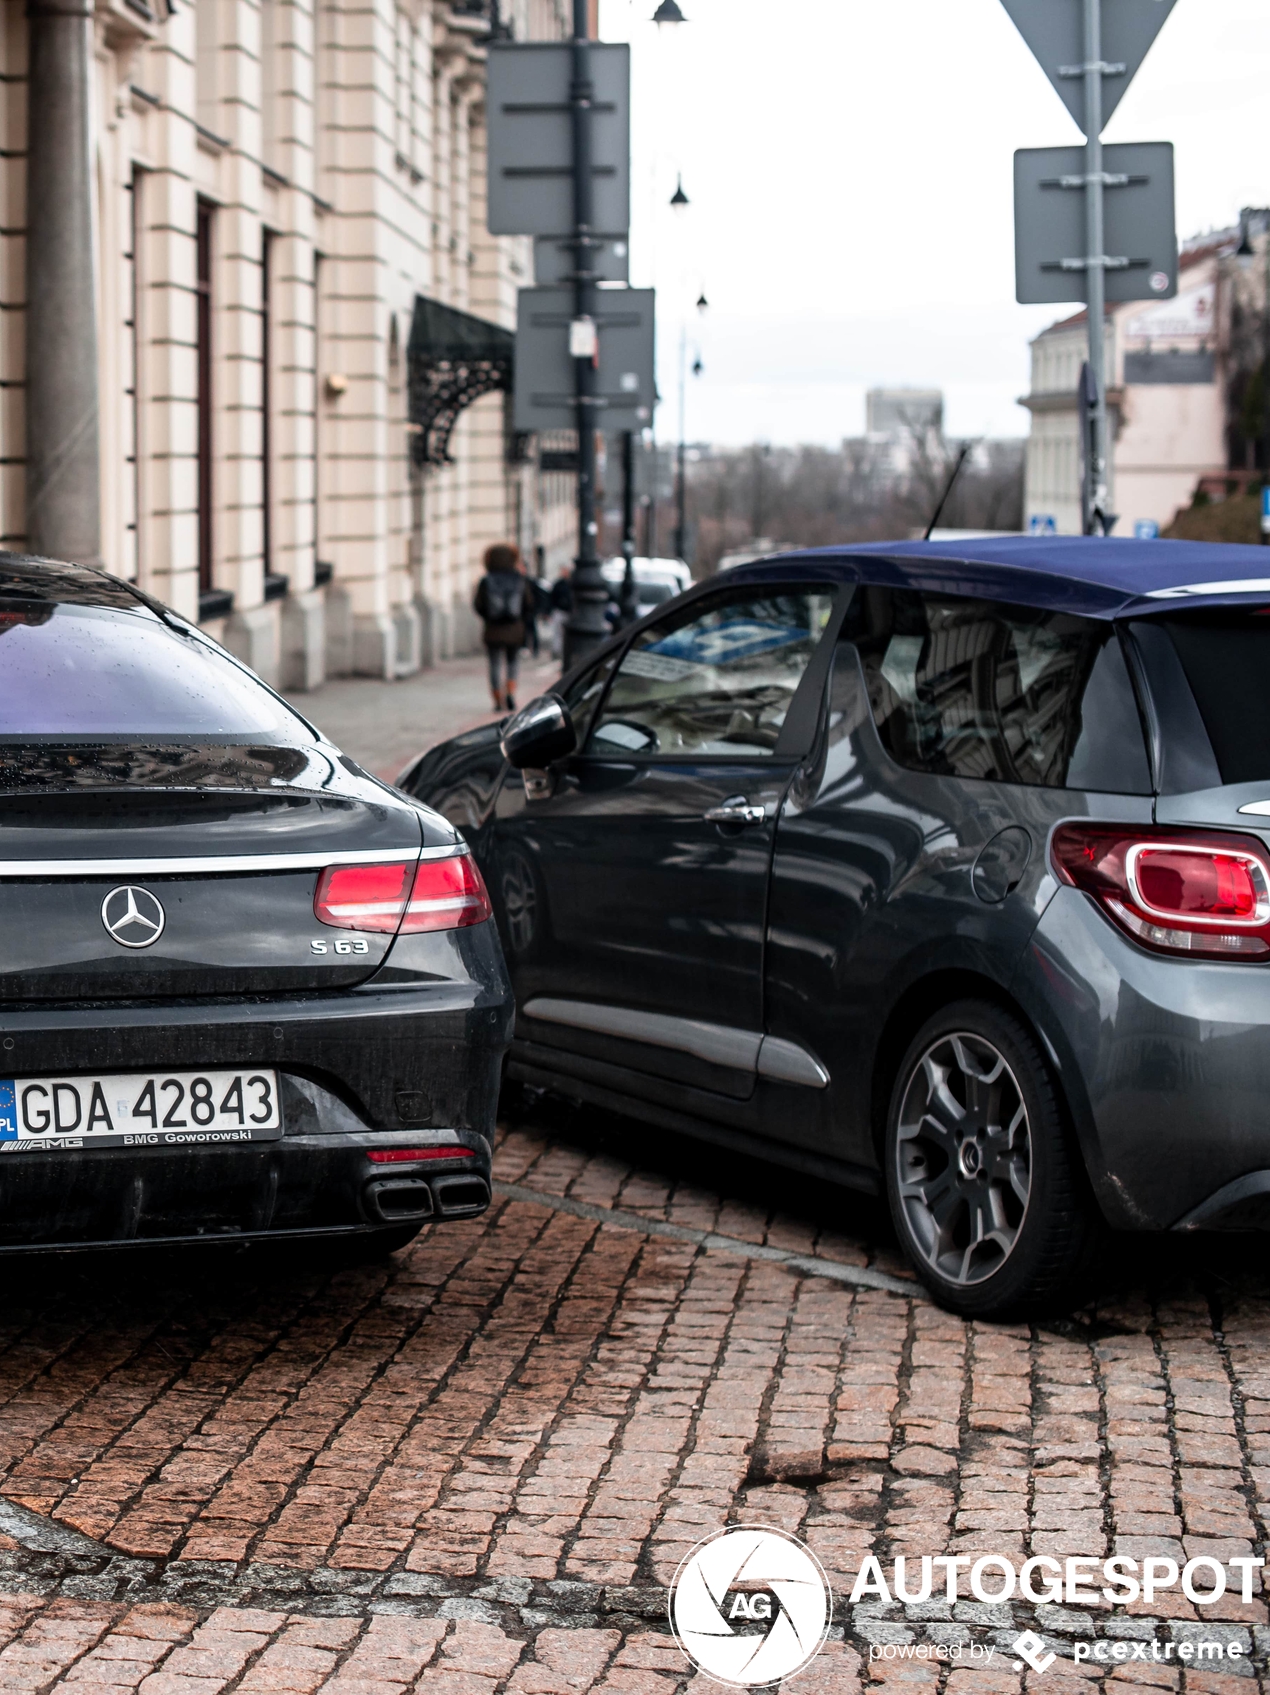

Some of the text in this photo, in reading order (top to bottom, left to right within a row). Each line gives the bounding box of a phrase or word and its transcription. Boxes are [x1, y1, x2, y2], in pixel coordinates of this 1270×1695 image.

[311, 939, 369, 955] S 63
[21, 1081, 114, 1134] GDA
[132, 1075, 273, 1129] 42843
[26, 1130, 252, 1150] AMG BMG Goworowski
